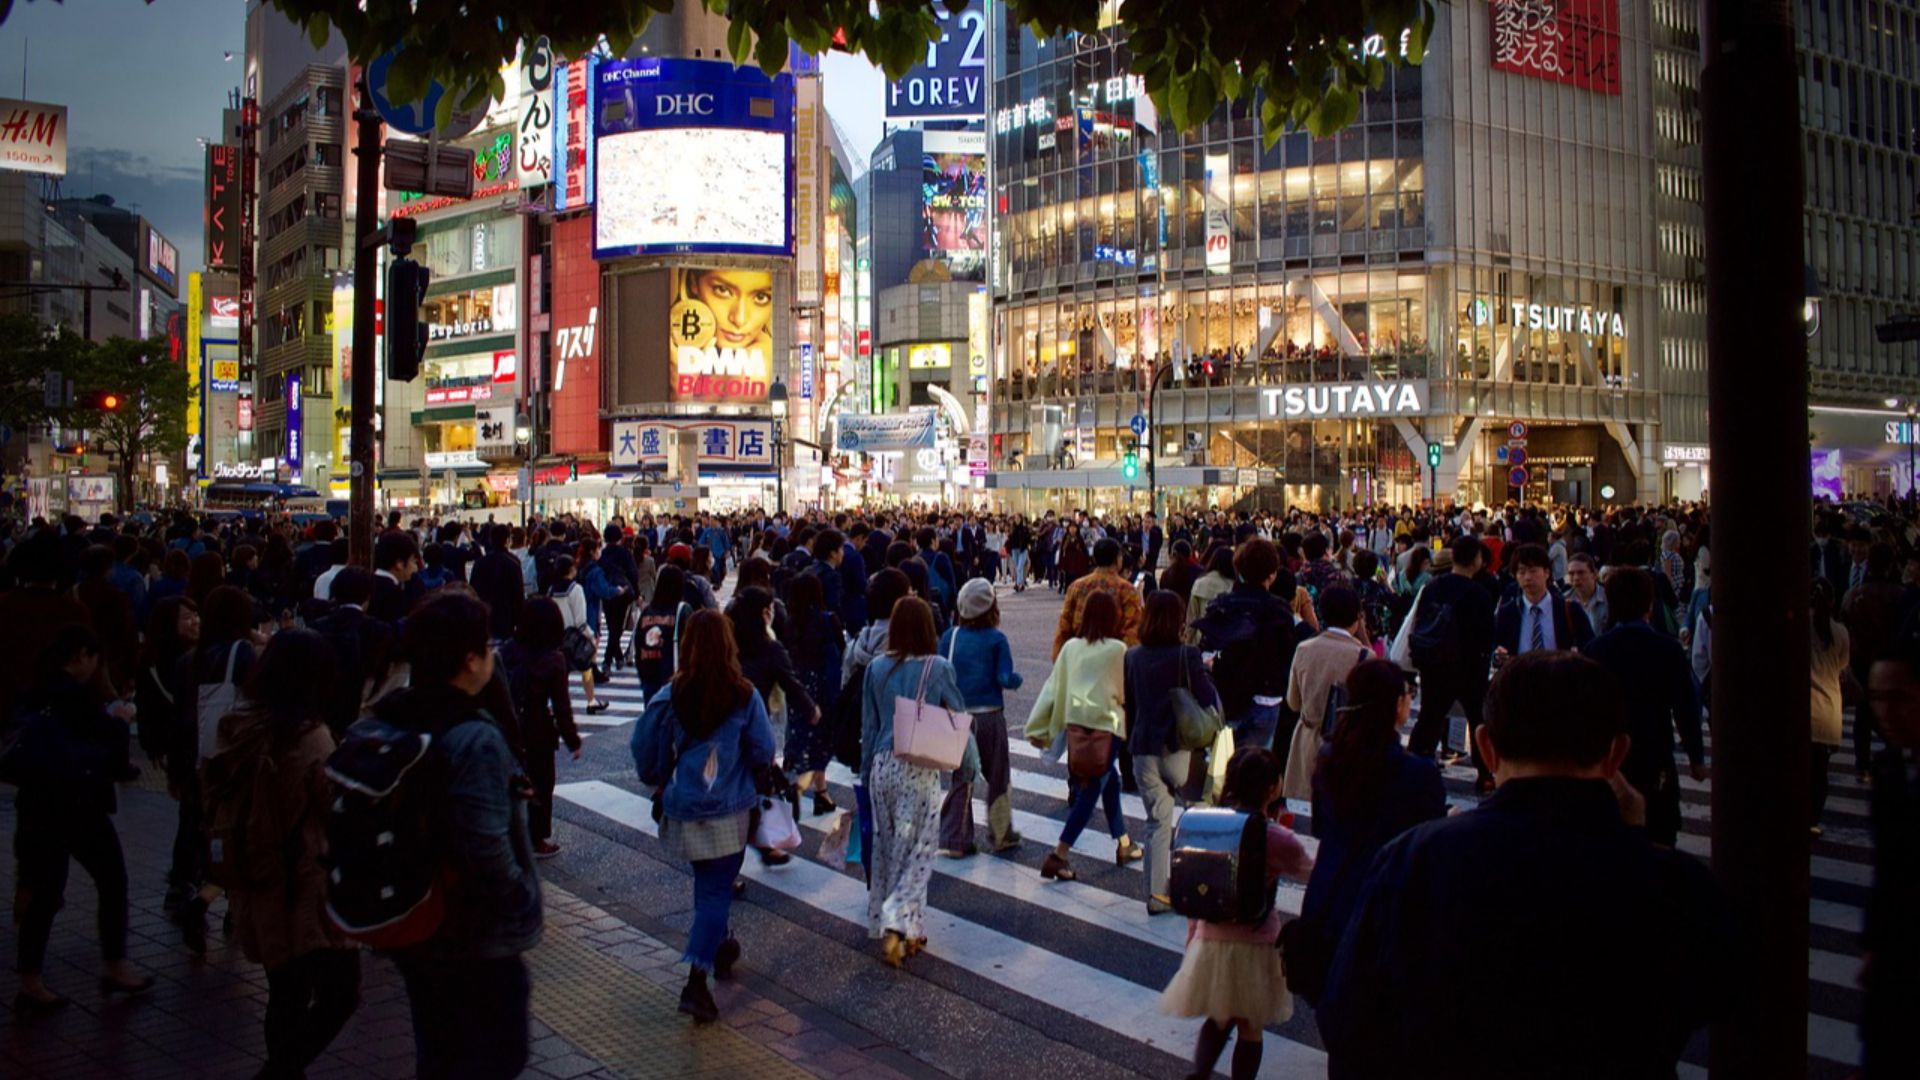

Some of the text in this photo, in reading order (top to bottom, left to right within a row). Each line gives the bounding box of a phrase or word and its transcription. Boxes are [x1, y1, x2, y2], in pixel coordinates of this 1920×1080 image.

[1495, 27, 1565, 77] 変える、
[603, 66, 660, 82] DHC Channel
[655, 93, 714, 116] DHC
[1, 108, 59, 148] H&M
[7, 151, 40, 164] 150m
[226, 145, 236, 183] TOKYO
[1512, 302, 1626, 338] TSUTAYA
[554, 306, 598, 392] クスリ
[677, 345, 767, 376] DMM
[677, 374, 766, 397] Bitcoin
[1262, 384, 1421, 416] TSUTAYA
